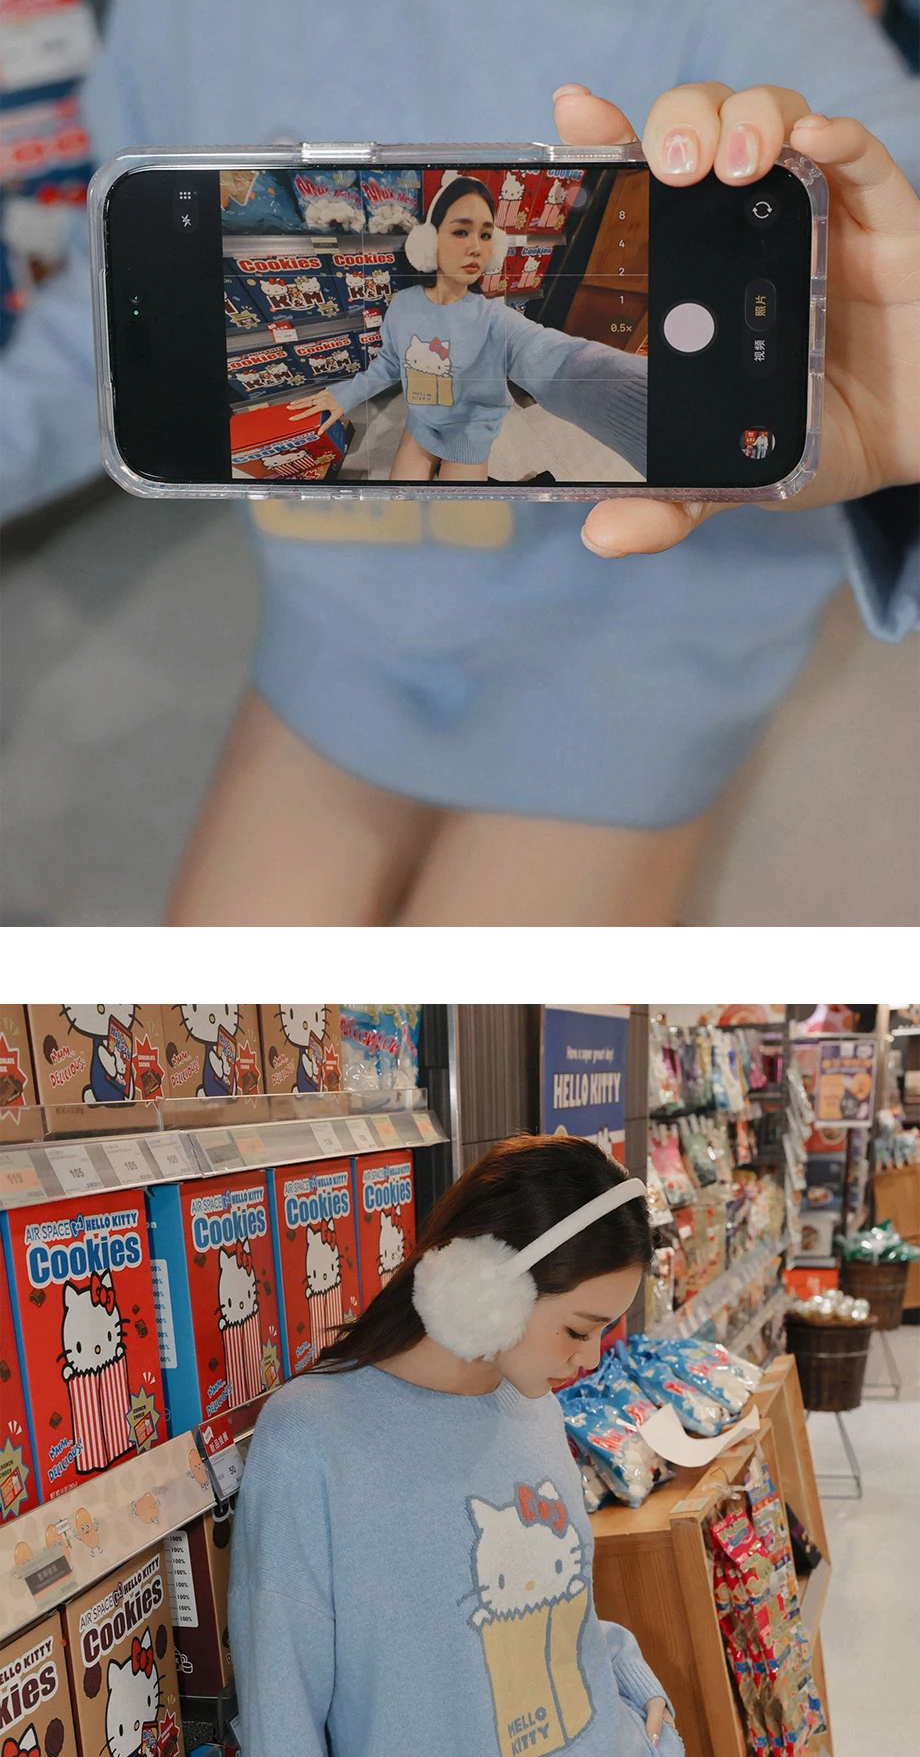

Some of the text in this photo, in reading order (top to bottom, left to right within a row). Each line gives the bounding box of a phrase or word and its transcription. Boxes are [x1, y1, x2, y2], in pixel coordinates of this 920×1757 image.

[619, 211, 626, 220] 8
[618, 239, 625, 248] 4
[239, 257, 321, 272] Cookies
[618, 267, 625, 277] 2
[620, 295, 624, 304] 1
[553, 1071, 621, 1109] HELLO KITTY
[70, 1168, 85, 1179] 105
[26, 1211, 138, 1243] AIR SPACE HELLO KITTY
[194, 1208, 266, 1250] Cookies
[30, 1235, 142, 1284] Cookies
[229, 1465, 237, 1476] 50
[91, 1557, 160, 1621] SPACE HELLO KITTY
[83, 1578, 163, 1664] Cookies
[507, 1706, 547, 1739] HELLO
[511, 1722, 550, 1757] KITTY
